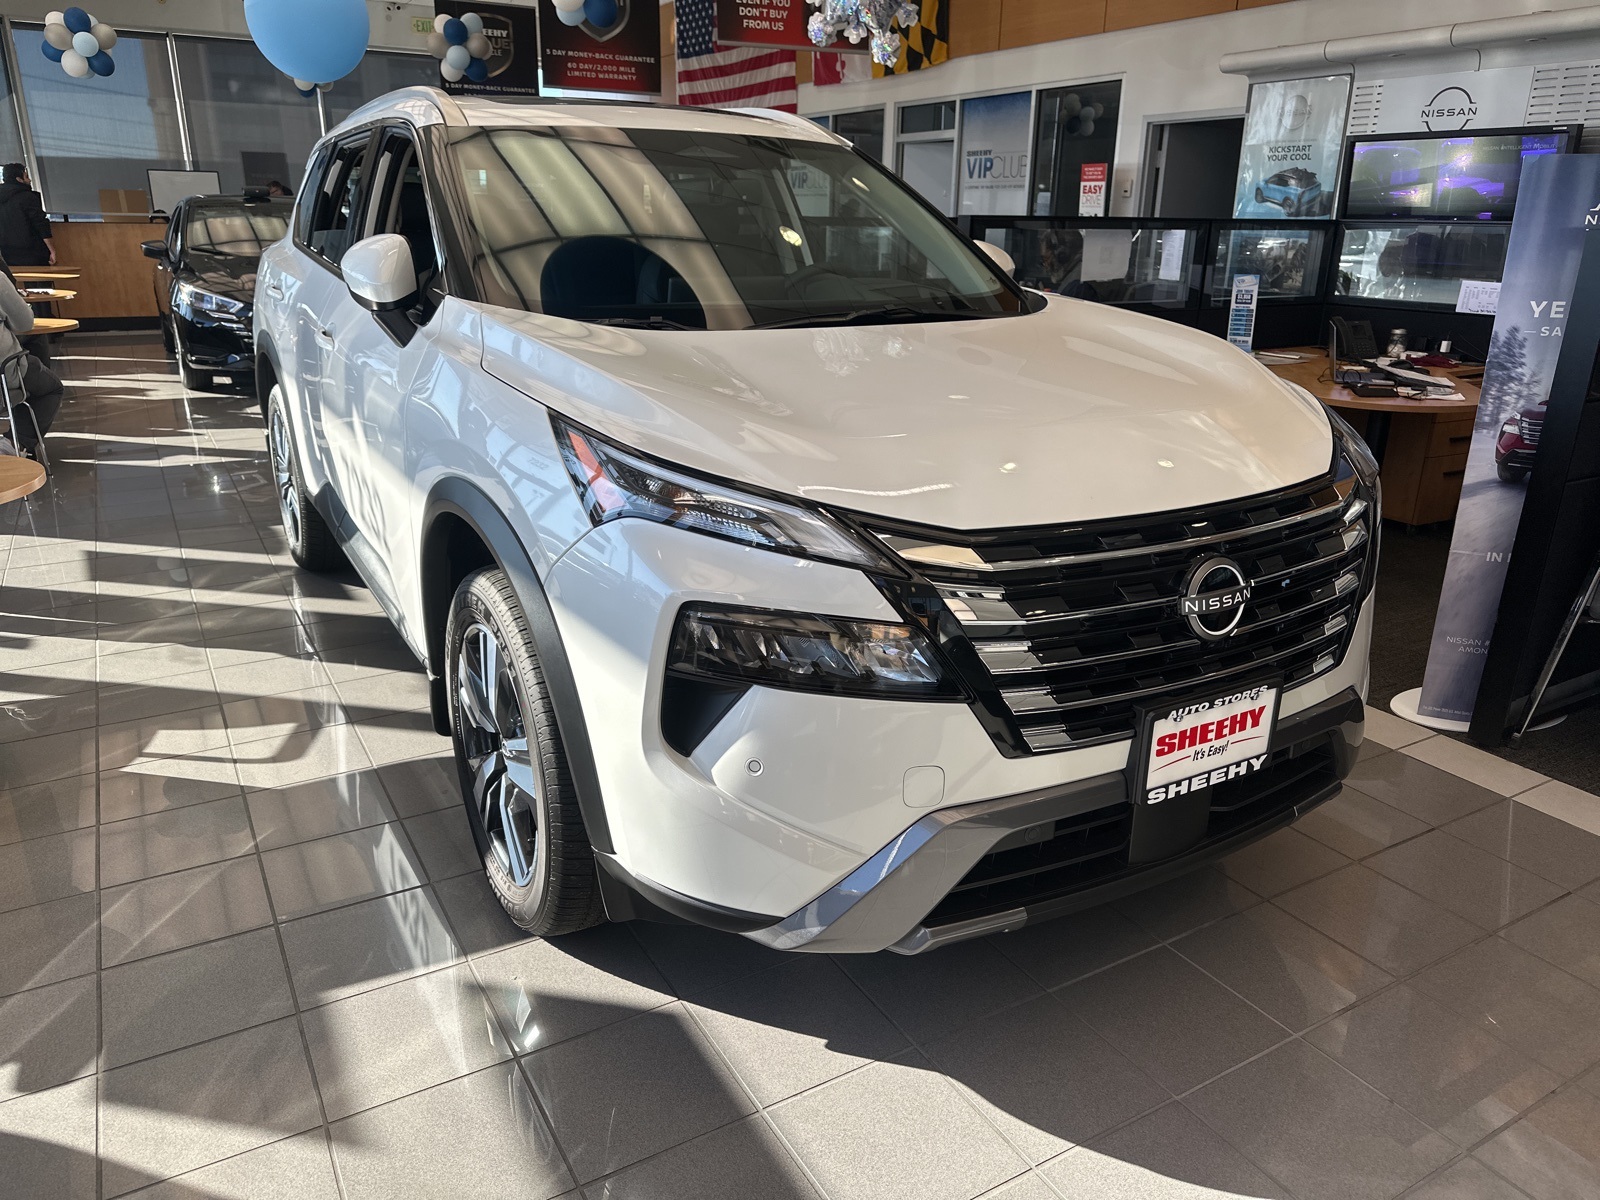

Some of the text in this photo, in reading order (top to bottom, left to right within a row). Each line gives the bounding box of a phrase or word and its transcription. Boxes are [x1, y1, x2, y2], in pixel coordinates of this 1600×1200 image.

[739, 7, 788, 19] DON'T BUY
[416, 19, 431, 32] EXIT
[743, 19, 784, 30] FROM US
[482, 28, 508, 38] EEHY
[567, 50, 613, 60] MONEY-BACK
[615, 55, 655, 63] GUARANTEE
[567, 70, 637, 81] LIMITED WARRANTY
[502, 86, 536, 94] GUARANTEE
[1421, 107, 1478, 118] NISSAN
[1269, 145, 1312, 154] KICKSTART
[1267, 153, 1312, 162] YOUR COOL
[1082, 184, 1103, 195] EASY
[1081, 195, 1102, 205] DRIVE
[1486, 551, 1503, 563] IN
[1185, 588, 1251, 614] NISSAN
[1446, 636, 1482, 646] NISSAN
[1167, 685, 1269, 720] AUTO STORES
[1155, 705, 1267, 758] SHEEHY
[1192, 740, 1230, 762] It's Easy!
[1147, 754, 1268, 805] SHEEHY
